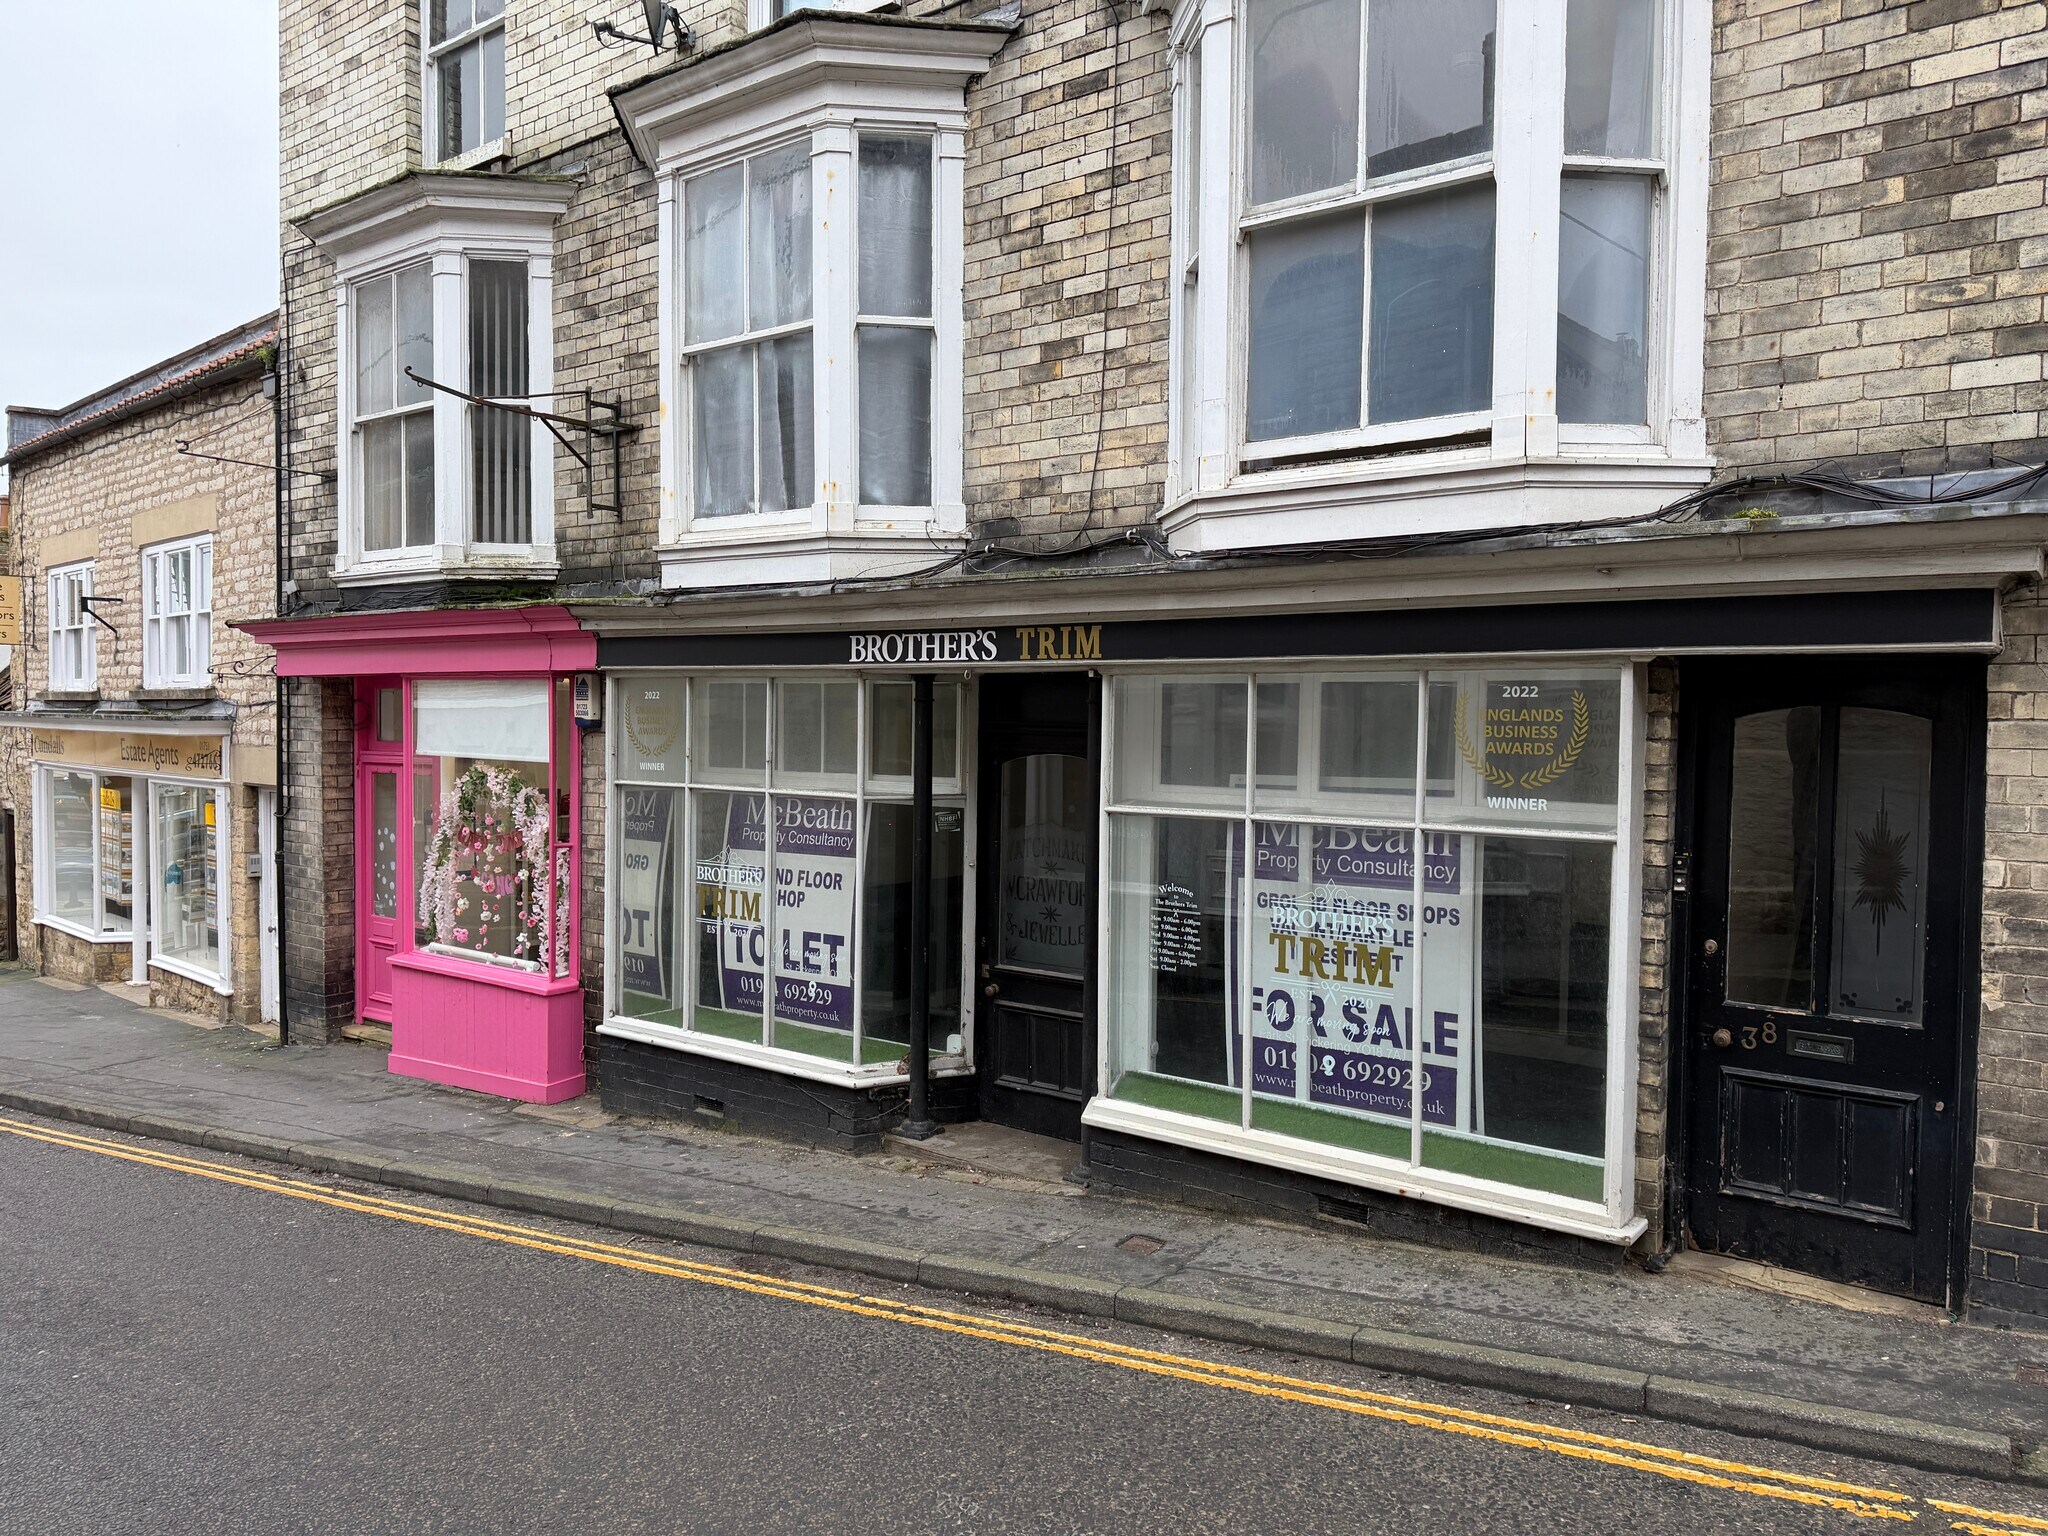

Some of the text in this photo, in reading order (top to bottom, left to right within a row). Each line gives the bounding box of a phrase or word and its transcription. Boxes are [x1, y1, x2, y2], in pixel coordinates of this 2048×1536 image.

[849, 626, 1102, 662] BROTHER'S TRIM
[645, 691, 660, 700] 2022
[1502, 686, 1539, 698] 2022
[1480, 709, 1564, 722] ENGLANDS
[1484, 725, 1558, 739] BUSINESS
[120, 738, 179, 770] Estate Agents
[1485, 742, 1555, 755] AWARDS
[640, 762, 665, 771] WINNER
[744, 796, 853, 831] McBeath
[1487, 796, 1548, 811] WINNER
[742, 827, 854, 851] Propty Consultancy
[696, 866, 763, 887] BROTHER'S
[1257, 850, 1457, 884] Propty Consultancy
[797, 869, 842, 891] FLOOR
[1158, 883, 1194, 898] Welcome
[695, 884, 762, 923] TRIM
[775, 889, 806, 908] HOP
[1165, 899, 1185, 907] Brothers
[1186, 901, 1198, 909] Trim
[1271, 905, 1395, 937] BROTHER'S
[1393, 929, 1427, 948] LE
[783, 929, 845, 974] LET
[1269, 933, 1395, 989] TRIM
[1291, 987, 1374, 1010] EST 2020
[1265, 1001, 1392, 1042] We are moving soon
[1341, 1000, 1459, 1058] SALE
[1741, 1021, 1778, 1050] 38
